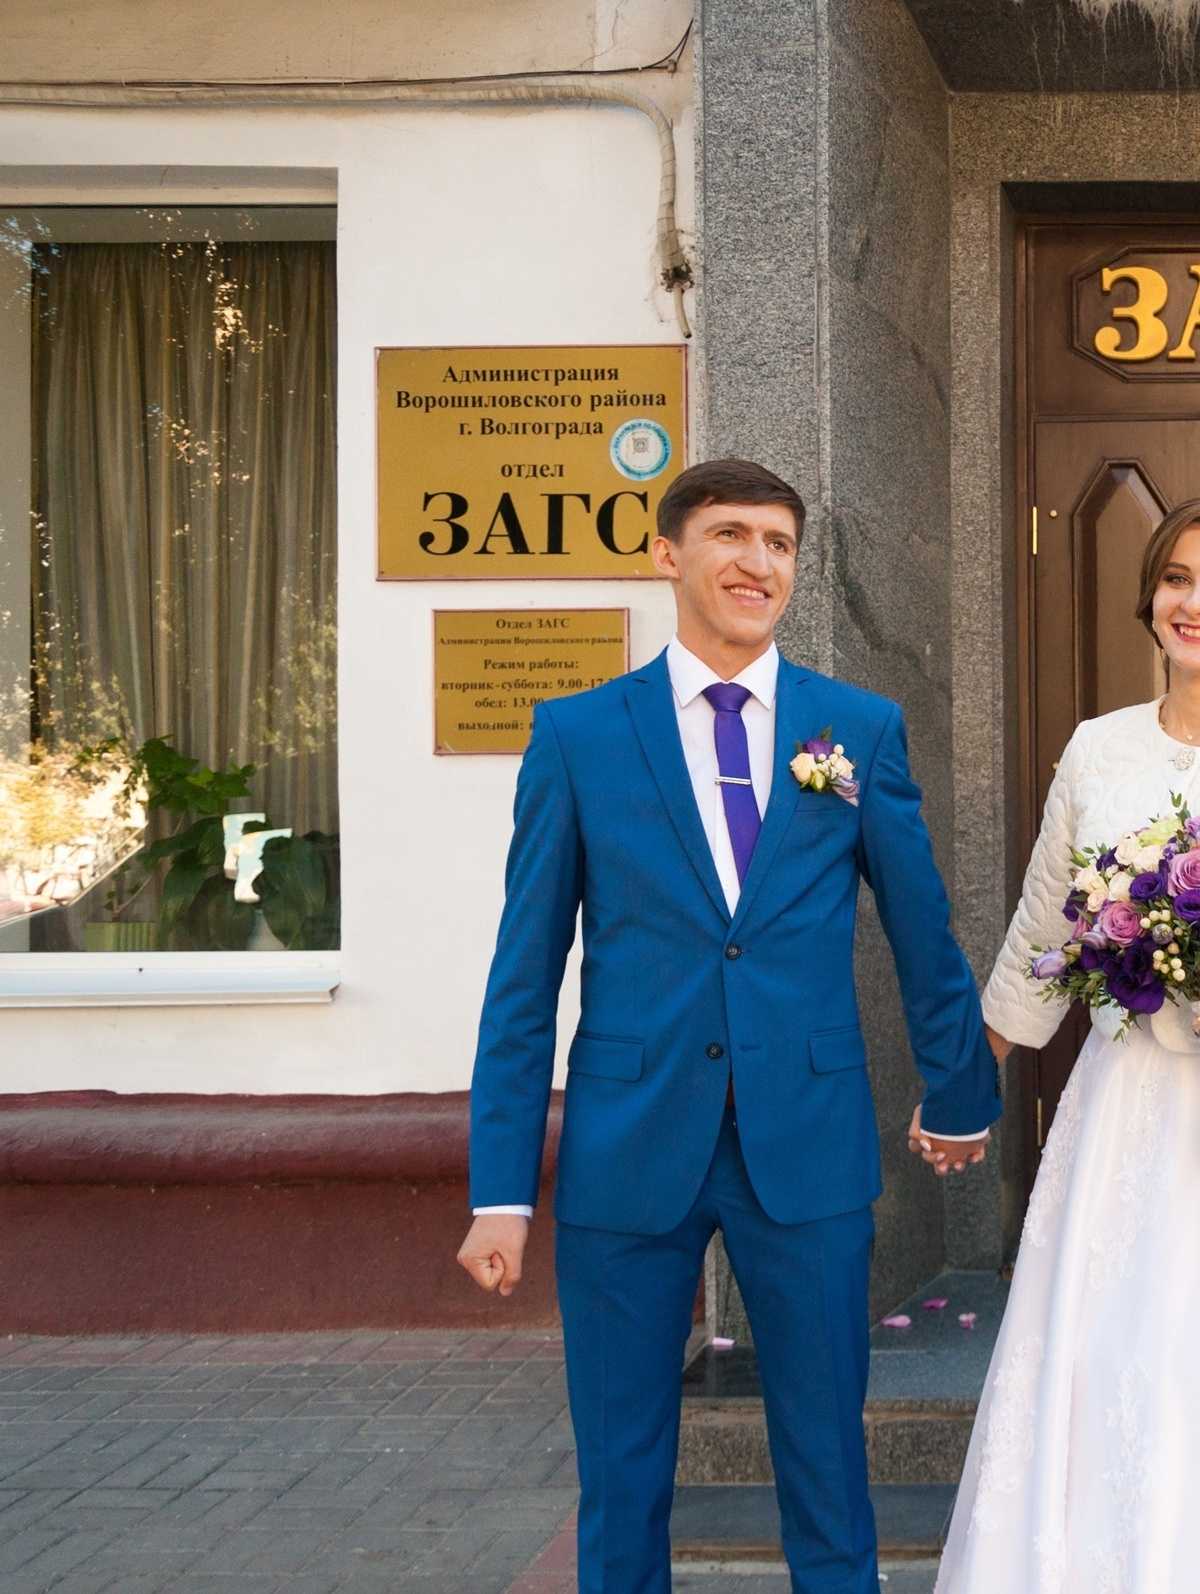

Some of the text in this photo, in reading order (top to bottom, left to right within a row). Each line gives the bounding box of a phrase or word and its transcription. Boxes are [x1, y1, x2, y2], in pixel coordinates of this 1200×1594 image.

[442, 365, 619, 387] Администрация
[396, 389, 667, 414] Ворошиловского района
[459, 417, 604, 437] г. Волгограда
[500, 464, 565, 479] отдел
[418, 491, 649, 556] ЗАГС
[495, 618, 570, 630] Отдел ЗАГС
[483, 658, 579, 672] Режим работы:
[474, 697, 507, 709] обед:
[457, 719, 524, 731] выходной:
